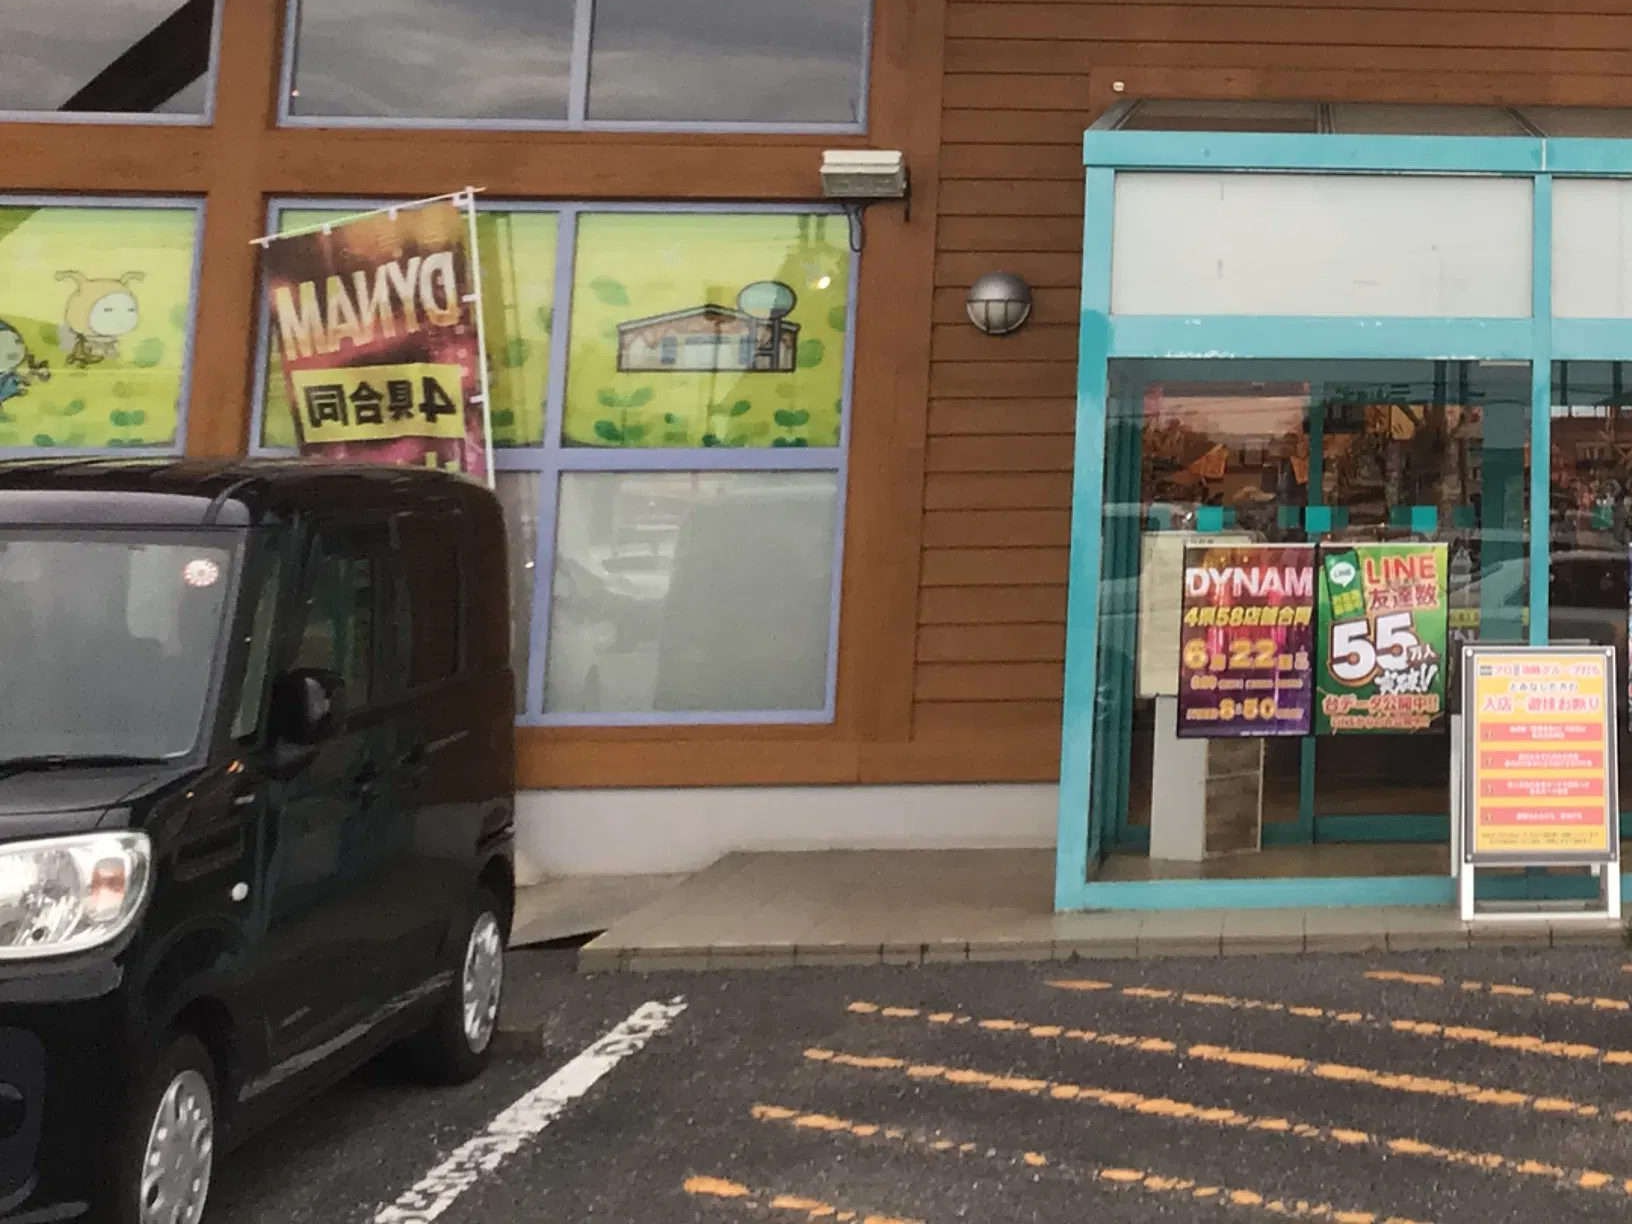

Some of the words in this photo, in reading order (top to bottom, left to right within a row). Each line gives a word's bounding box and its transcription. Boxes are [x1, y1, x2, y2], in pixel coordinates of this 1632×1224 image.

[1185, 567, 1314, 597] DYNAM
[1365, 555, 1437, 584] LINE
[1368, 584, 1438, 610] 友達数
